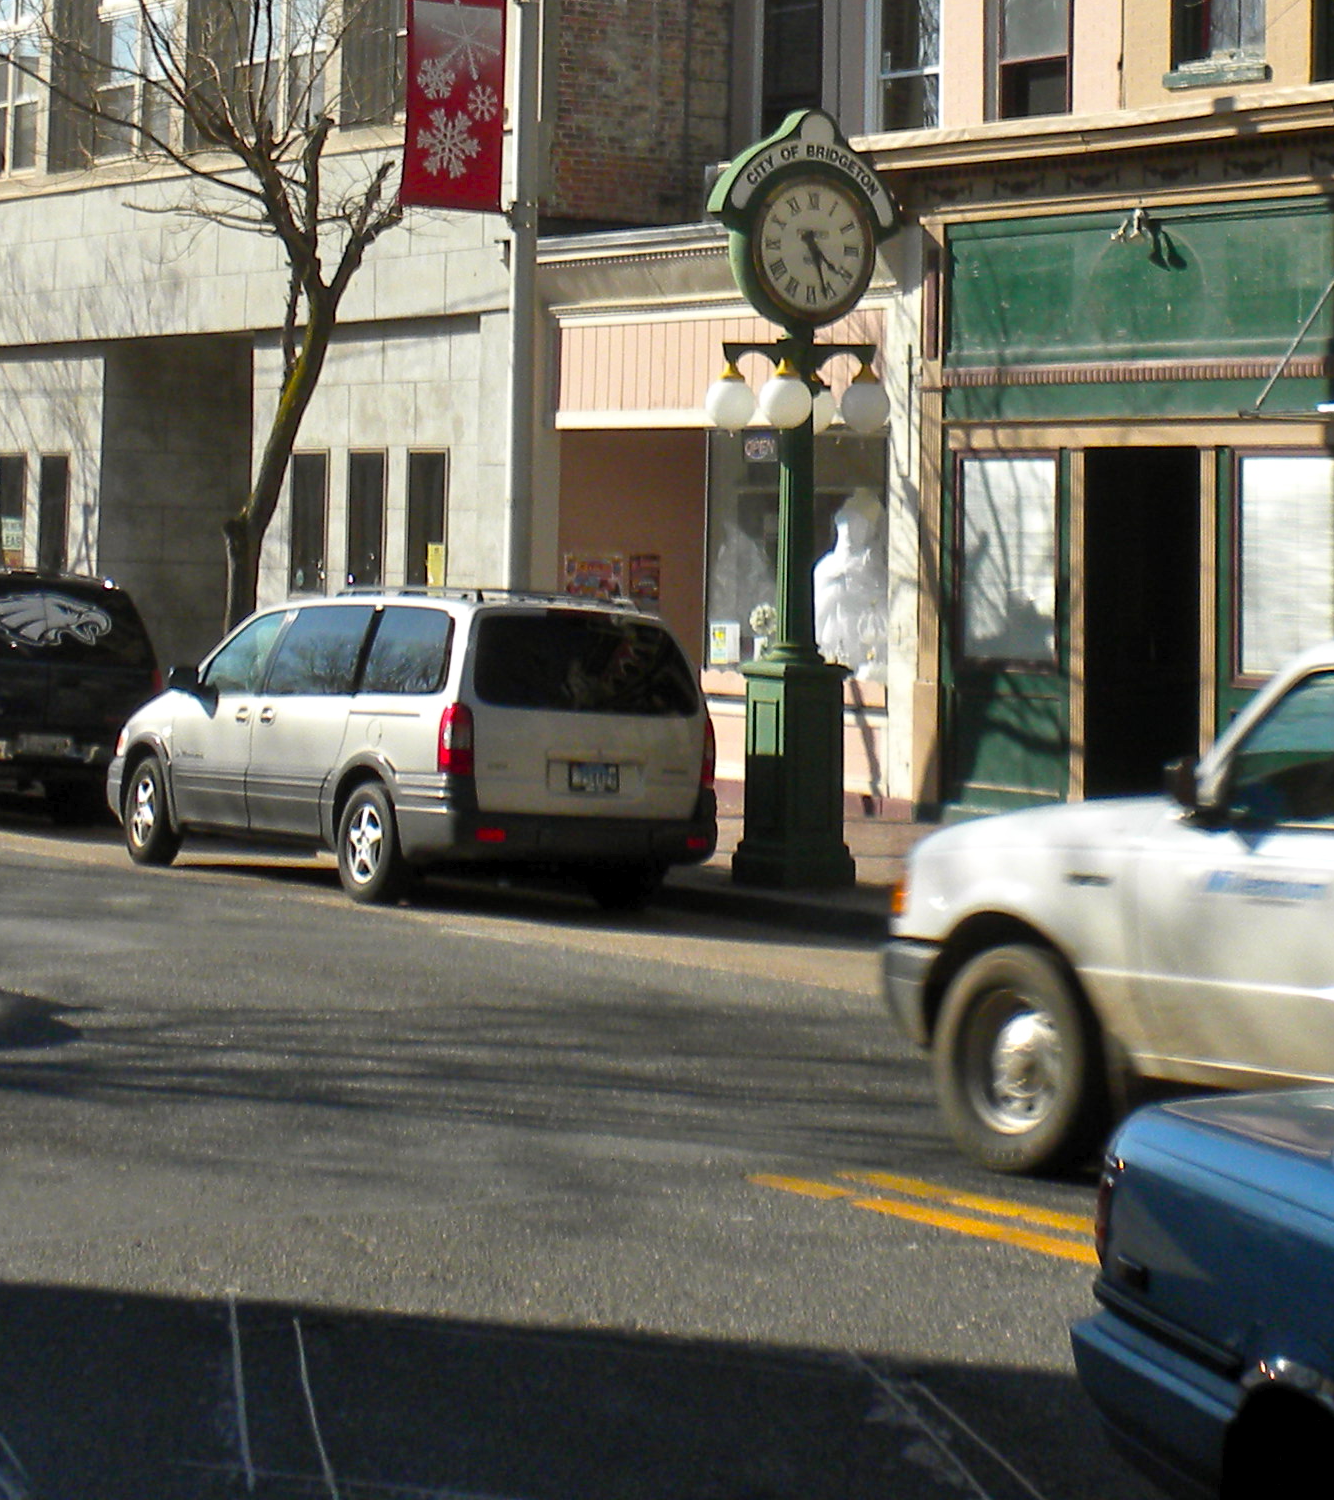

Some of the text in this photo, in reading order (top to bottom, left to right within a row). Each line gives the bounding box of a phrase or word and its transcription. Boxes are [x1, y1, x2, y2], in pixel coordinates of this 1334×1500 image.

[747, 144, 880, 197] CITY OF BRIDGETON
[744, 439, 775, 457] OPEN
